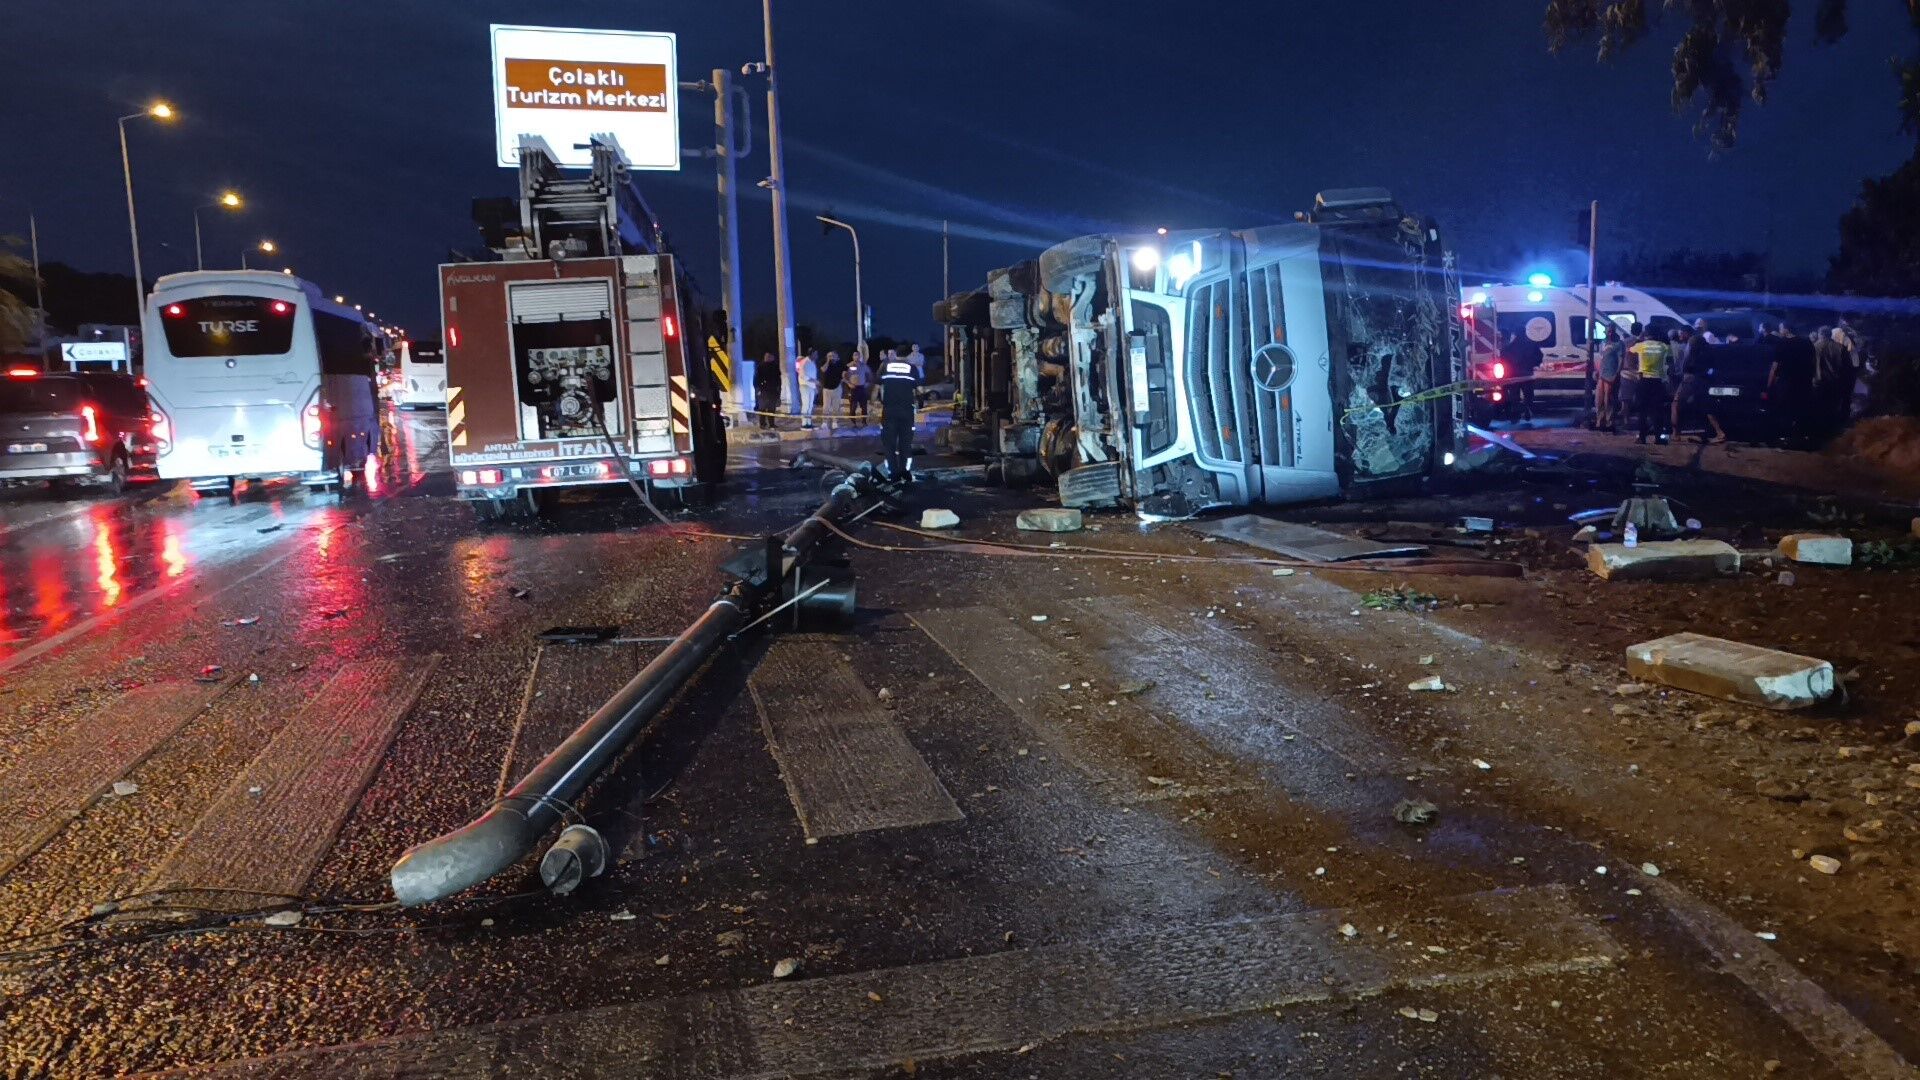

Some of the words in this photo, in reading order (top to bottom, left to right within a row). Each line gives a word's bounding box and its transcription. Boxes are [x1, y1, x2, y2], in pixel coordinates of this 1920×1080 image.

[548, 67, 624, 86] Çolaklı
[506, 86, 581, 105] Turizm
[586, 89, 666, 108] Merkezi
[484, 441, 526, 453] ANTALYA
